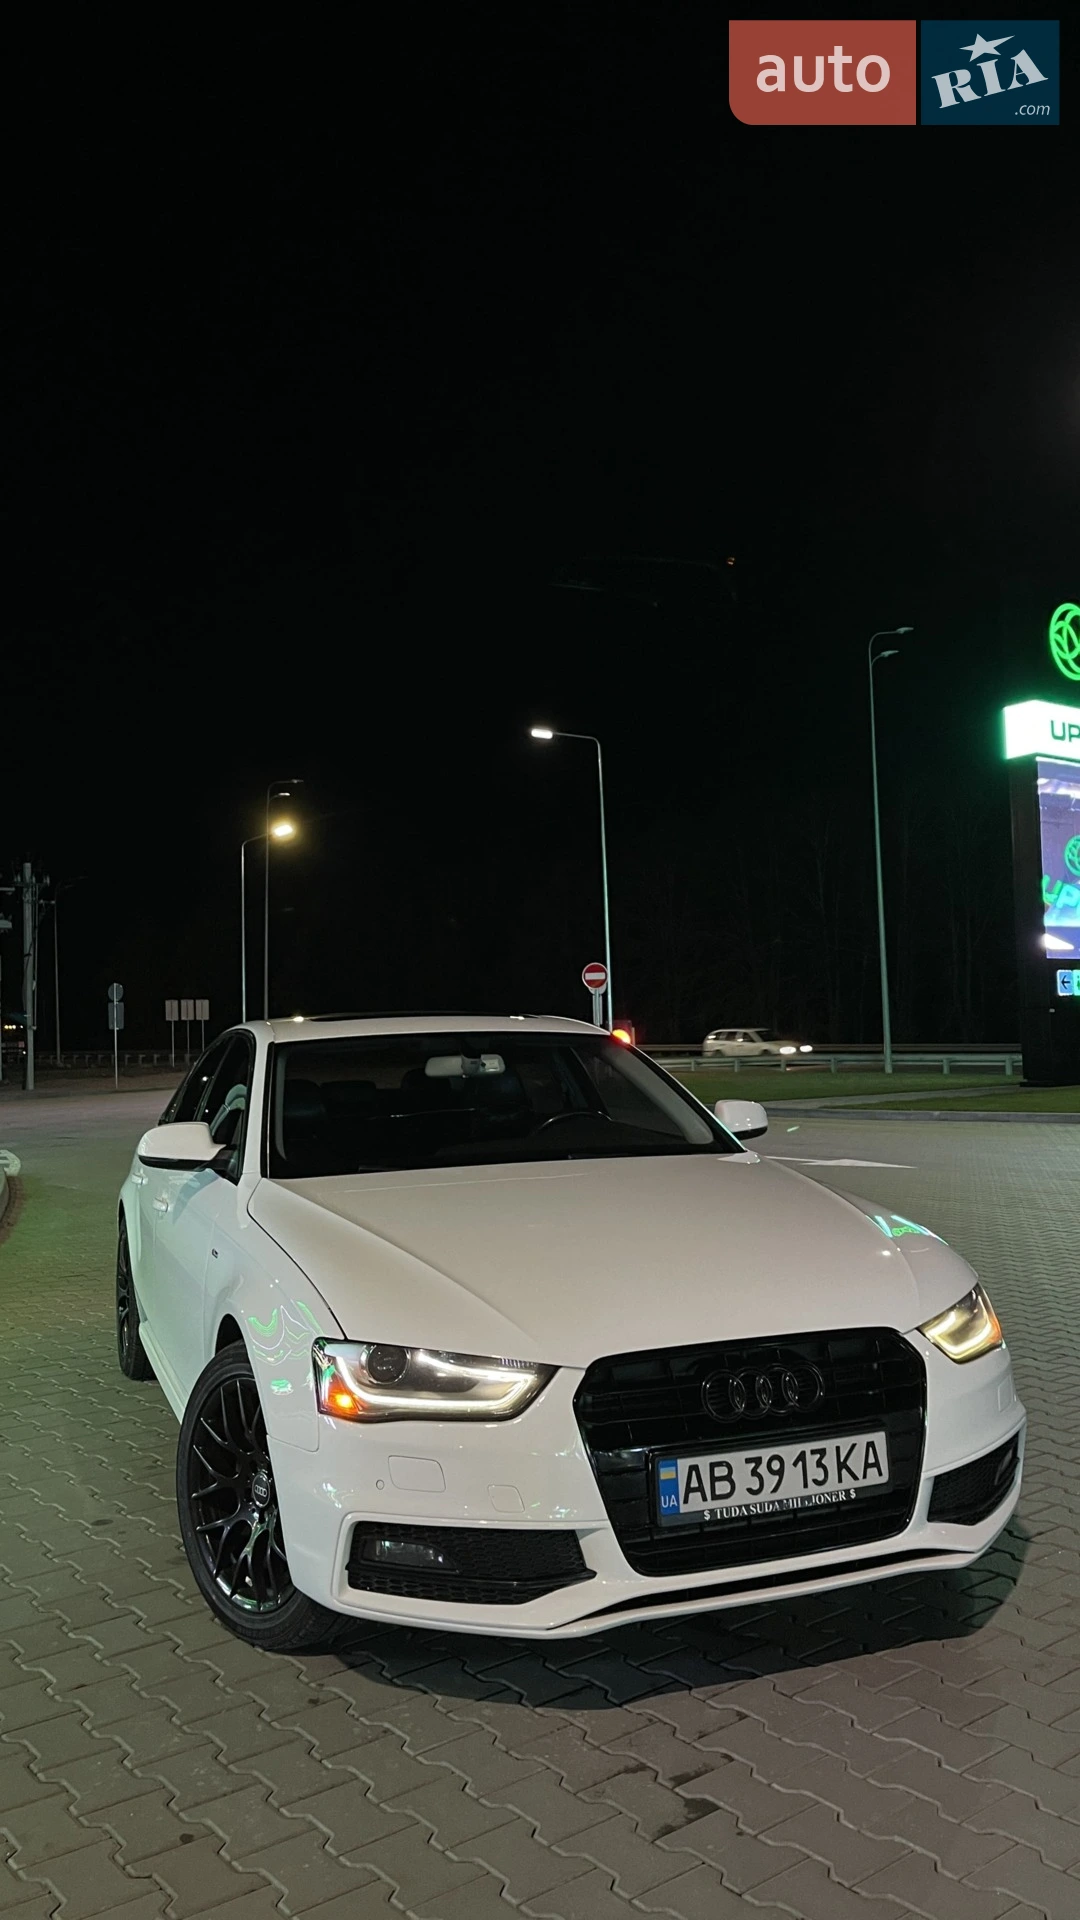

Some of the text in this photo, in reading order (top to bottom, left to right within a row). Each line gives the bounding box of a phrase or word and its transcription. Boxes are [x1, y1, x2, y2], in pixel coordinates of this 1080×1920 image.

[1042, 874, 1080, 909] UP
[683, 1460, 736, 1504] AB
[835, 1440, 883, 1484] KA
[661, 1495, 678, 1508] UA
[714, 1505, 748, 1520] TUDA
[750, 1501, 780, 1515] SUDA
